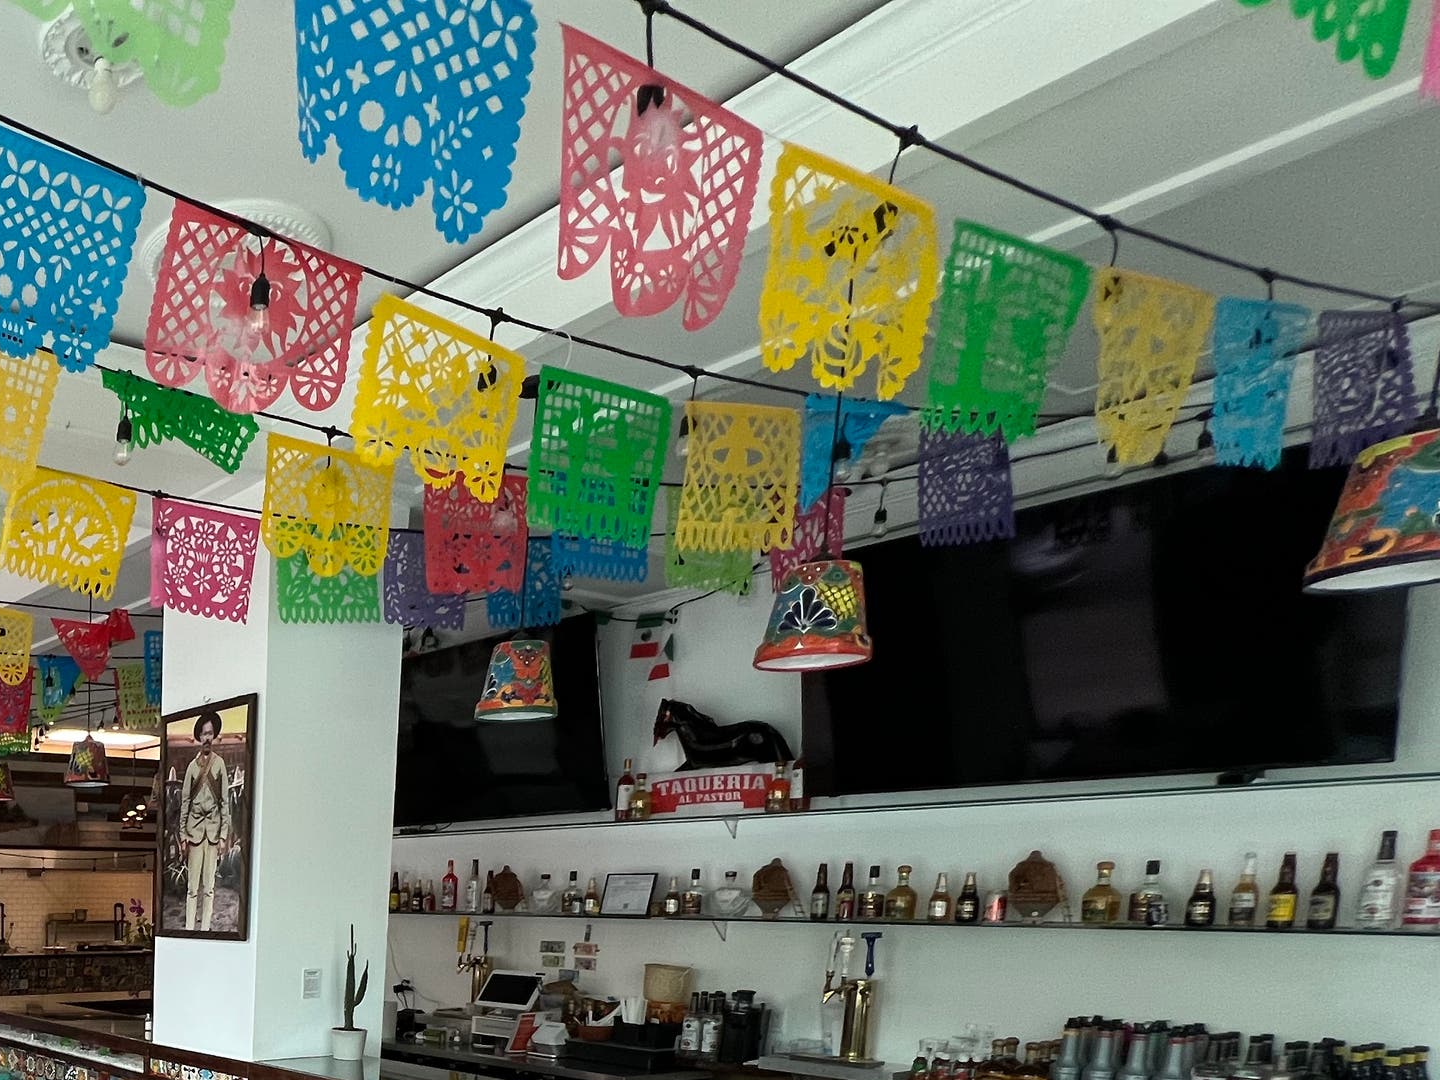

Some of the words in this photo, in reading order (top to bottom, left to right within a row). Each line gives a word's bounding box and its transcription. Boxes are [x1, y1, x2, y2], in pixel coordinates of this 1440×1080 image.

[657, 775, 766, 796] TAQUERIA
[679, 795, 692, 804] AL
[696, 792, 741, 803] PASTOR
